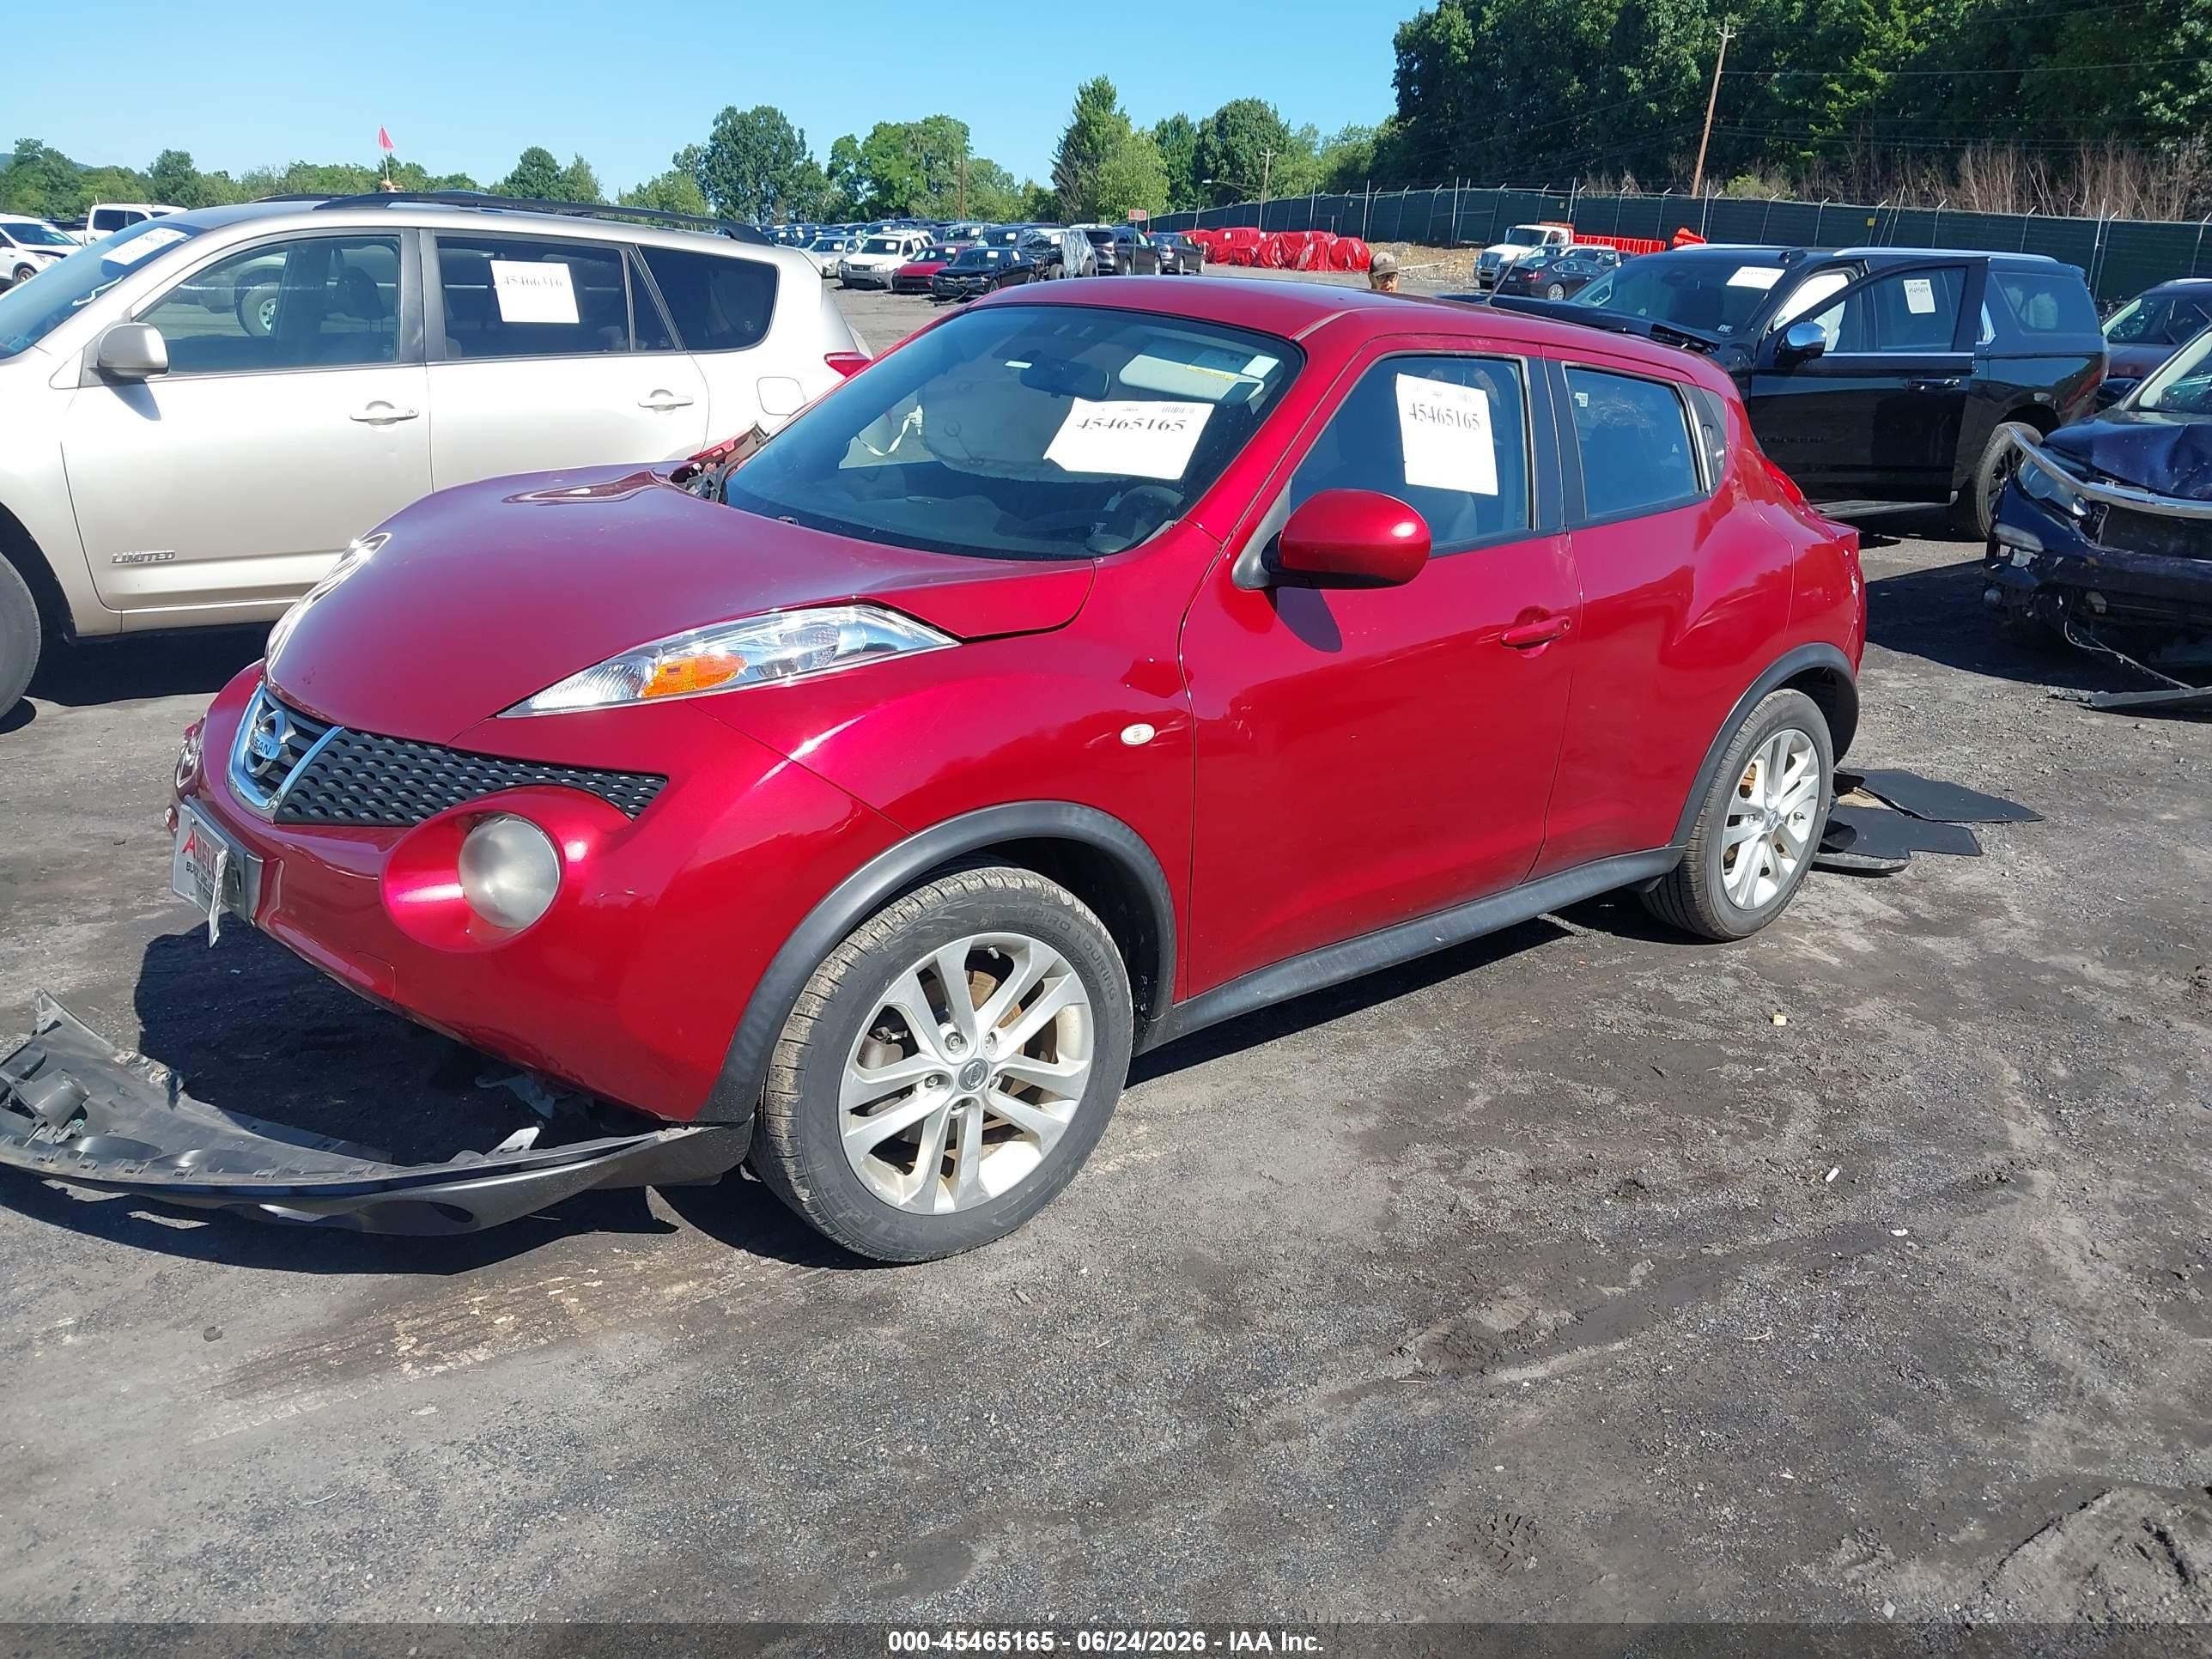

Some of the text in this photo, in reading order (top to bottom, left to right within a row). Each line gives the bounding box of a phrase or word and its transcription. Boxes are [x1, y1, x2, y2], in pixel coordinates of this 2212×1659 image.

[1075, 416, 1188, 433] 45465165
[1408, 401, 1481, 431] 45465165
[111, 550, 176, 563] LIMITED
